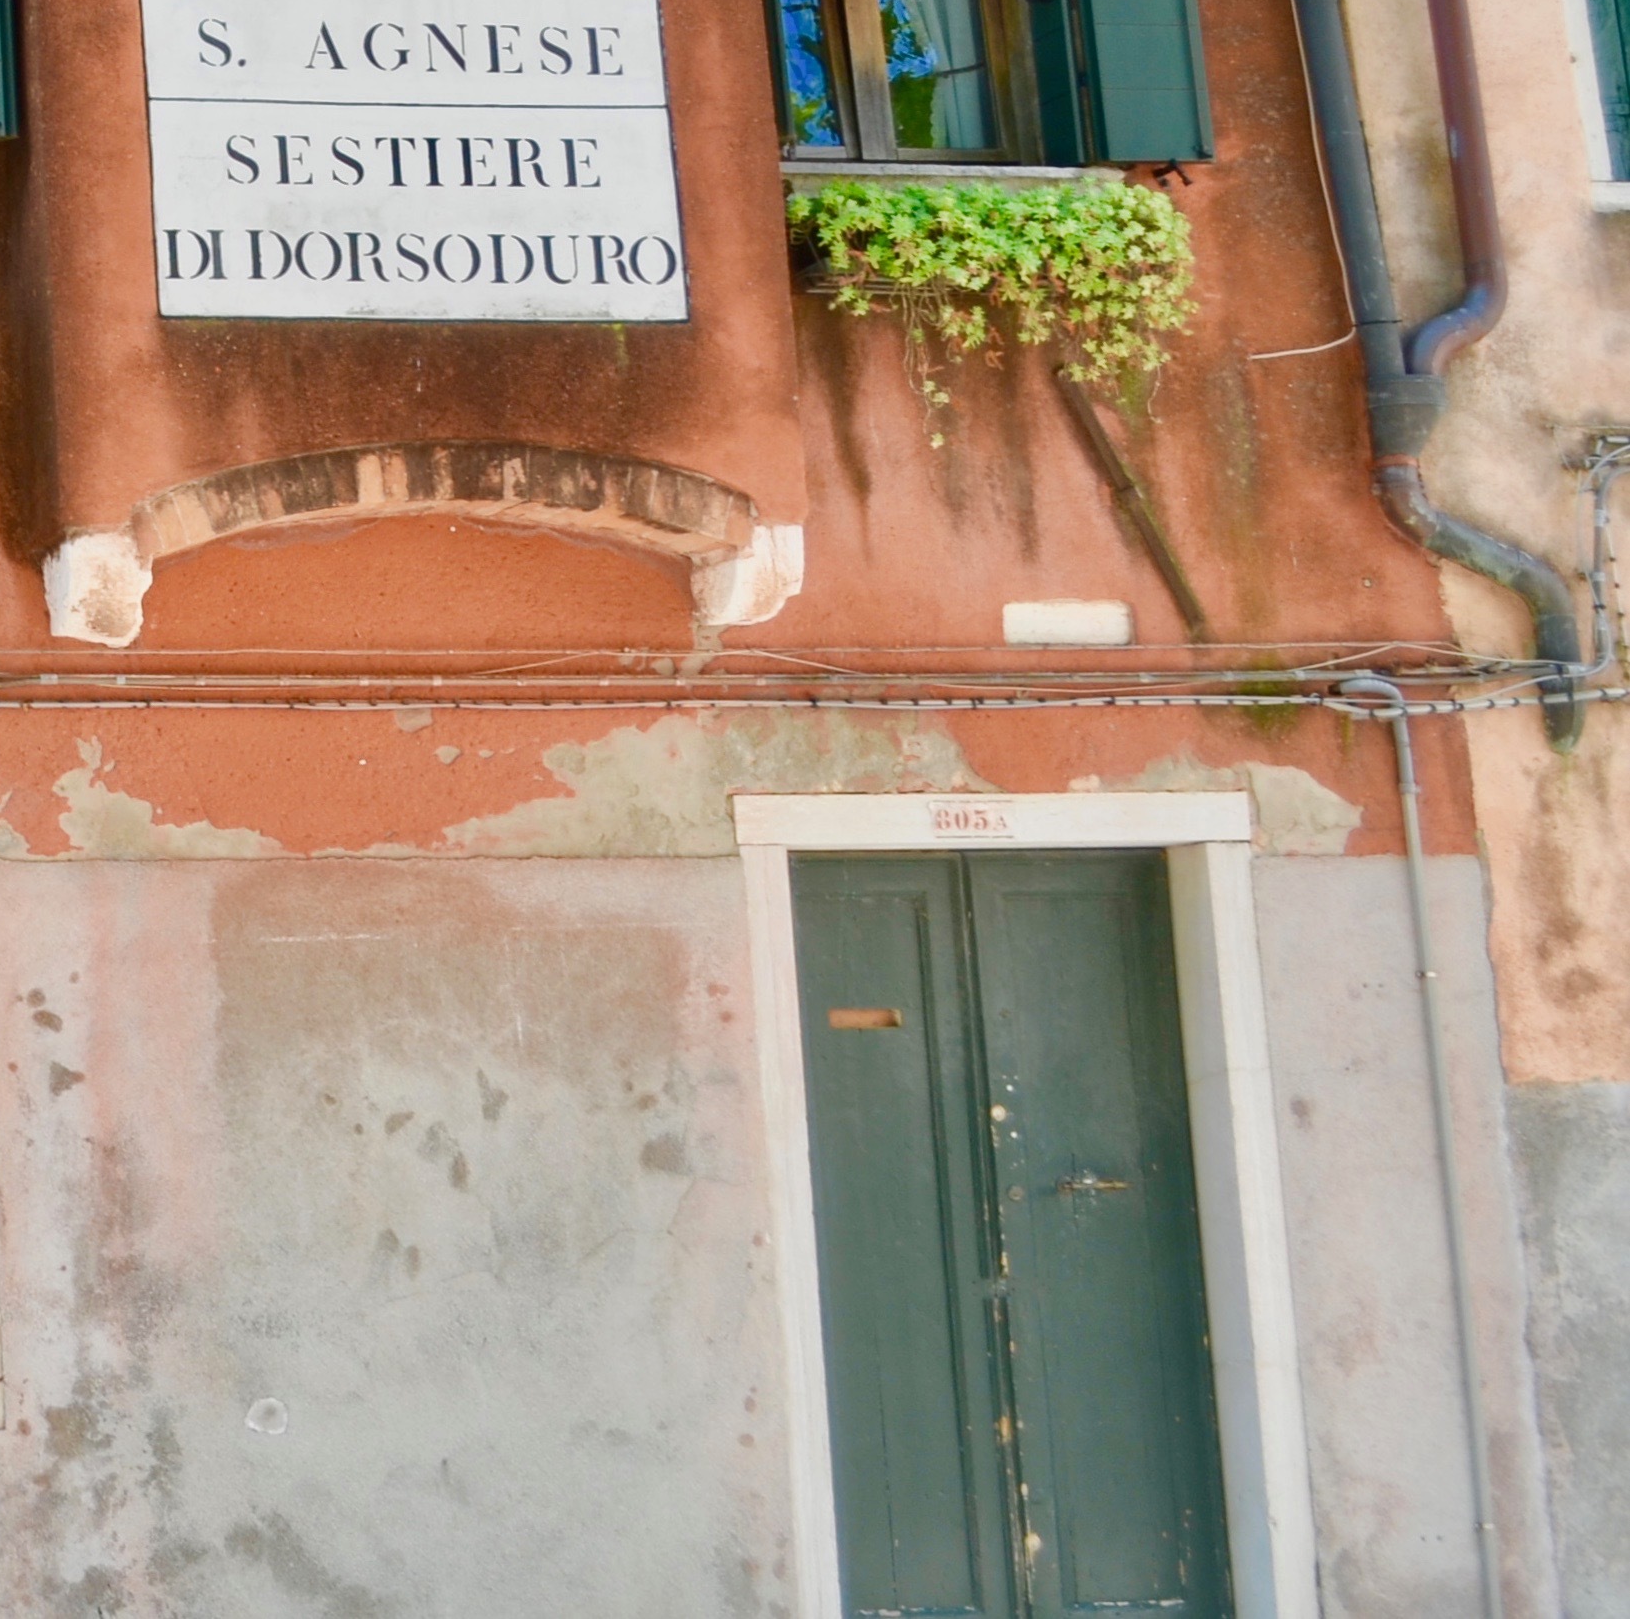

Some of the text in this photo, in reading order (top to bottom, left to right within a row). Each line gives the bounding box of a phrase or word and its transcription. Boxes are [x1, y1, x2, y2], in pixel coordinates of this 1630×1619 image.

[197, 18, 625, 76] S. AGNESE
[225, 134, 602, 188] SESTIERE
[163, 228, 678, 286] DI DORSODURO
